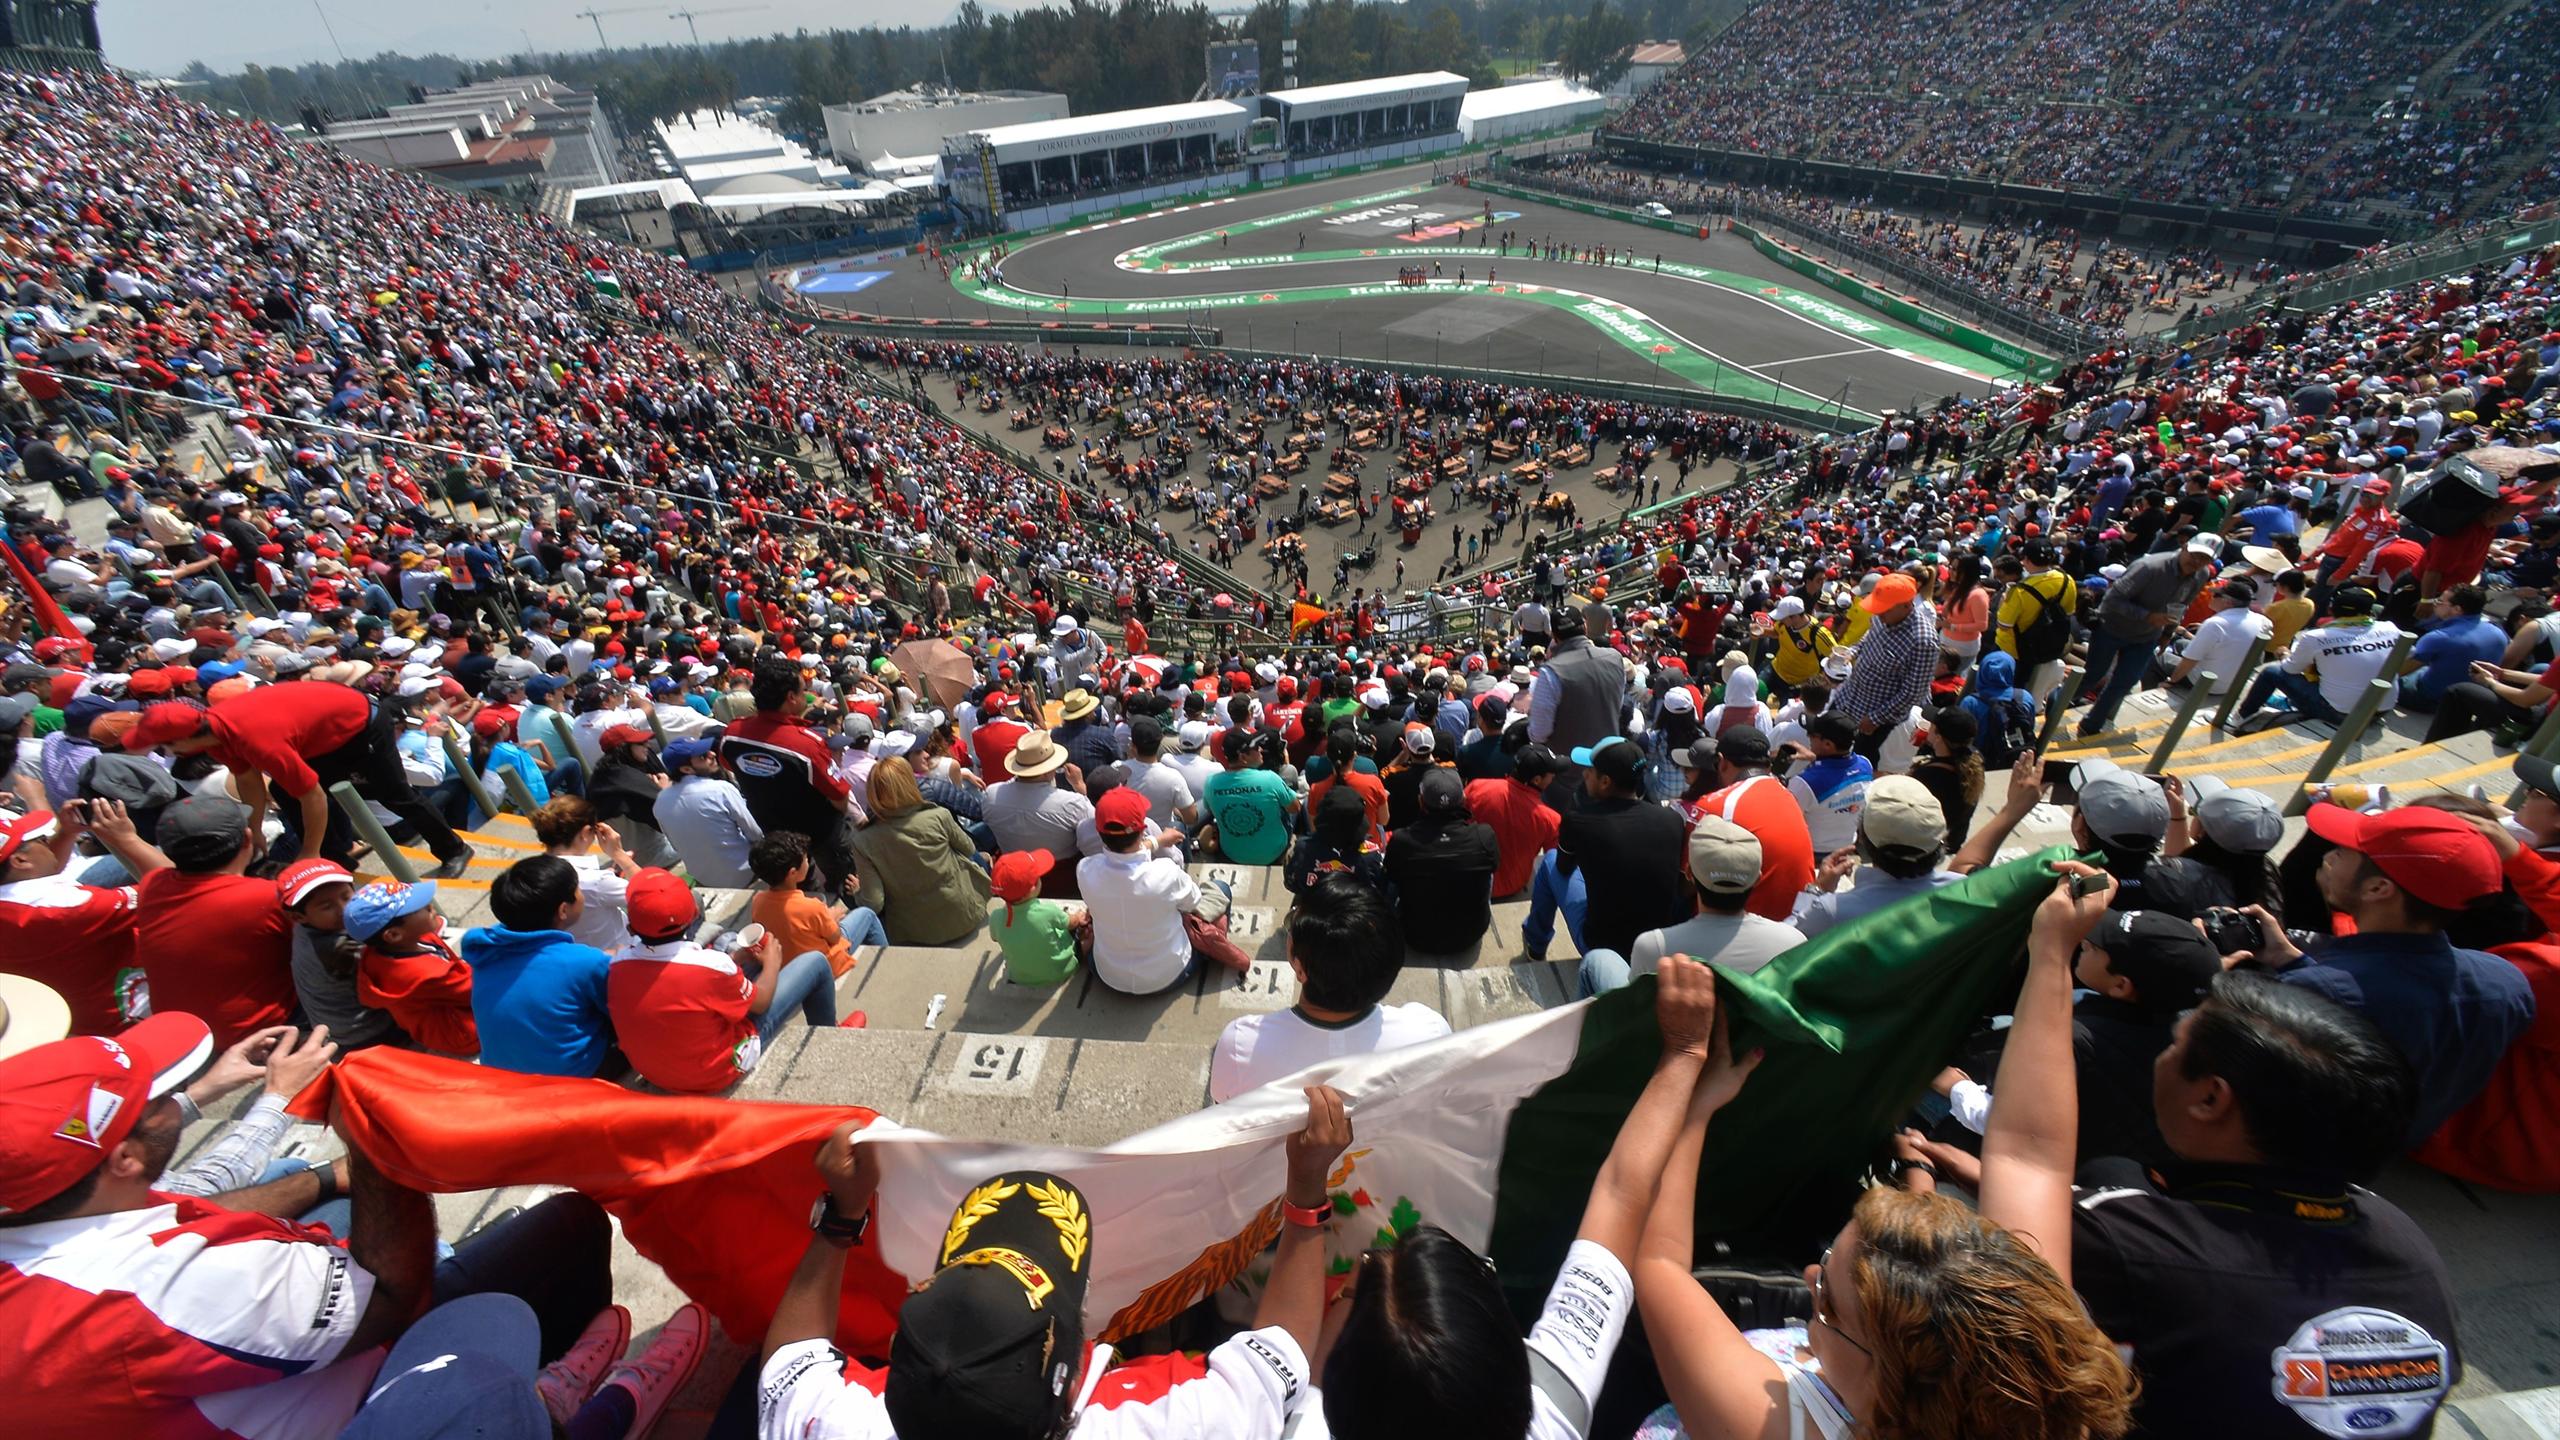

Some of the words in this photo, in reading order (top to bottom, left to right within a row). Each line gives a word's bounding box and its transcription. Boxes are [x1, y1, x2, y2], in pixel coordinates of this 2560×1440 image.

[1037, 137, 1081, 153] FORMULA
[1083, 135, 1101, 145] ONE
[1104, 128, 1144, 144] PADDOCK
[1124, 295, 1248, 312] Heineken
[1574, 302, 1652, 344] Heineken
[1213, 786, 1262, 796] PETRONAS
[968, 1045, 1025, 1081] 15
[311, 1256, 348, 1329] PIRELLI
[1563, 1266, 1614, 1296] BOSE
[1558, 1308, 1601, 1344] EPSON
[1244, 1338, 1299, 1402] PIRELLI
